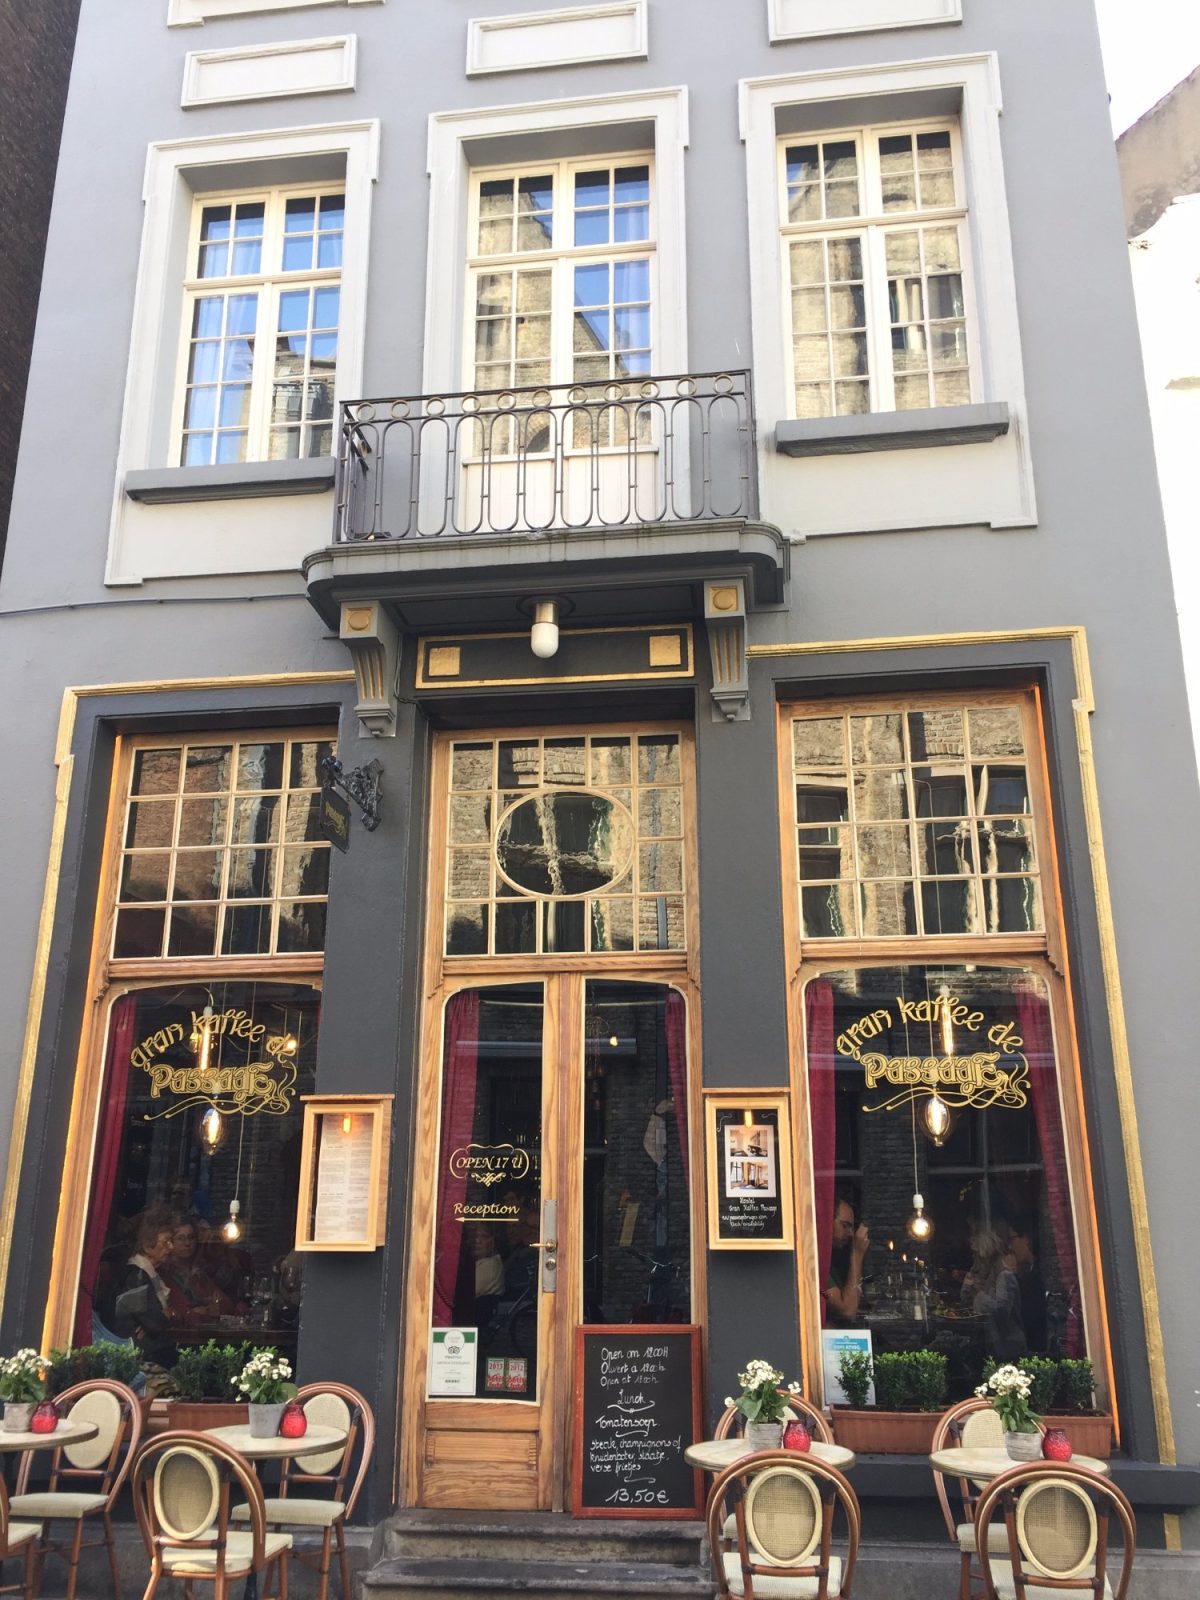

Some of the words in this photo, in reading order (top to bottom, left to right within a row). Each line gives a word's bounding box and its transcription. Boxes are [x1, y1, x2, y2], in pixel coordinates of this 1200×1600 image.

[836, 1009, 892, 1060] gran
[988, 1021, 1024, 1054] de
[131, 1023, 184, 1073] gran
[456, 1156, 495, 1170] OPEN
[495, 1157, 510, 1169] 17
[453, 1203, 519, 1217] Reception
[601, 1347, 624, 1366] Open
[600, 1376, 619, 1389] Open
[621, 1375, 631, 1384] at
[617, 1388, 646, 1404] Lunch
[605, 1488, 670, 1504] 13,50€
